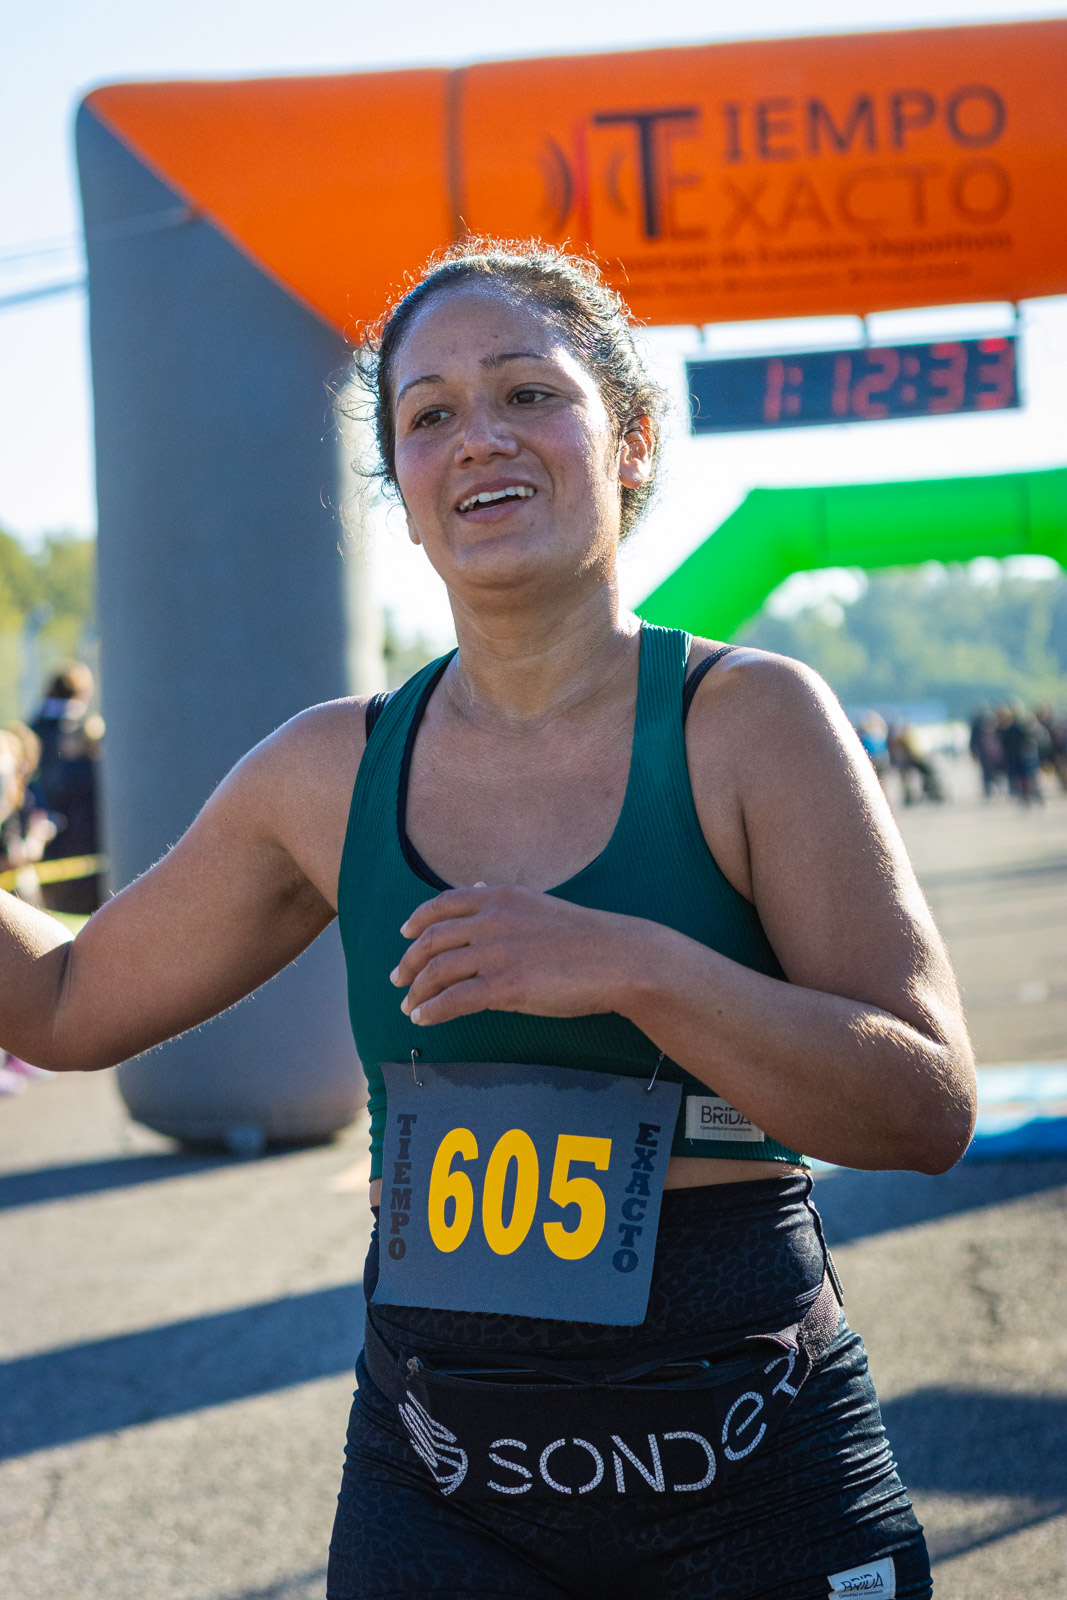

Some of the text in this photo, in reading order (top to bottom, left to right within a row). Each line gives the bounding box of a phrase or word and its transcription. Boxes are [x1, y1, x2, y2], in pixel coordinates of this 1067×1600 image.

[592, 84, 1007, 241] TIEMPO
[700, 1105, 752, 1126] BRIDA
[387, 1113, 418, 1261] TIEMPO
[427, 1127, 613, 1261] 605
[611, 1122, 662, 1274] EXACTO
[840, 1571, 884, 1592] BRIDA
